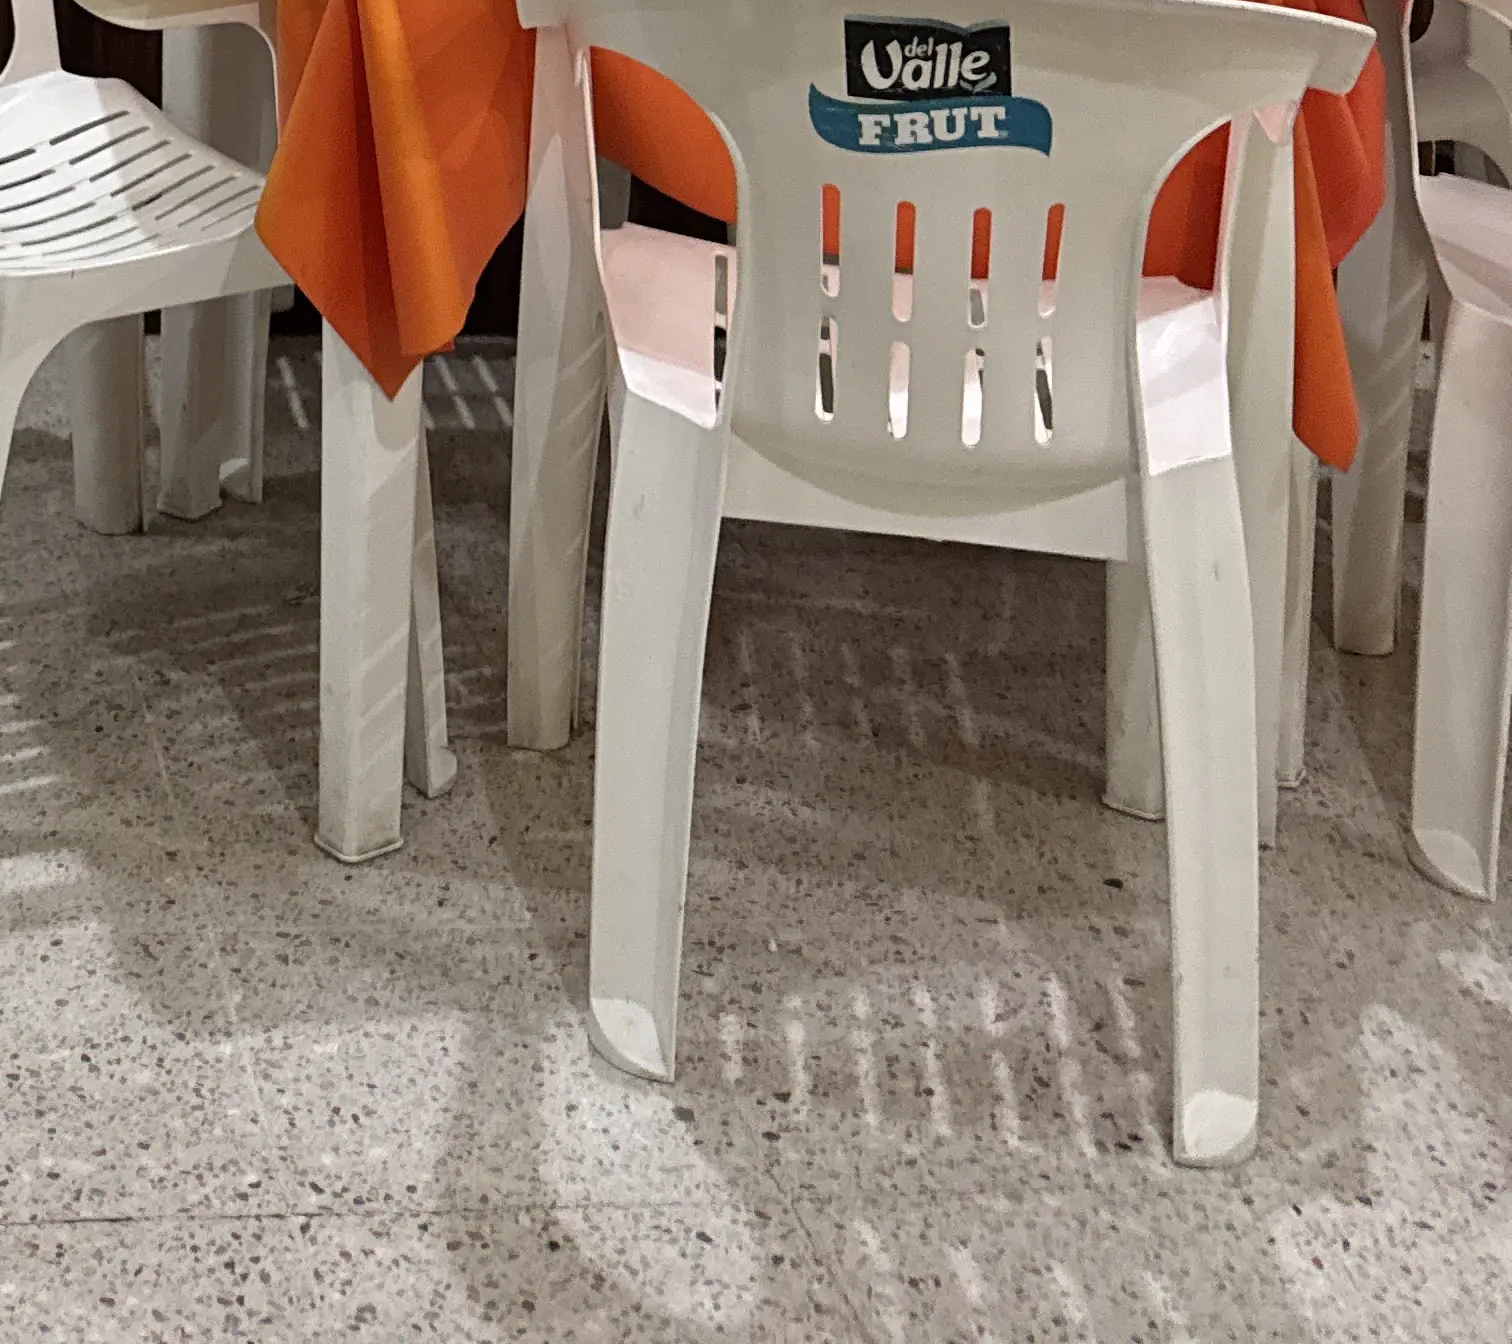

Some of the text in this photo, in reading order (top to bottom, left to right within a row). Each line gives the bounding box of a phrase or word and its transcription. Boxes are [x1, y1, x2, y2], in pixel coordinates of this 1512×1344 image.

[860, 35, 991, 91] del Valle
[857, 105, 1007, 146] FRUT
